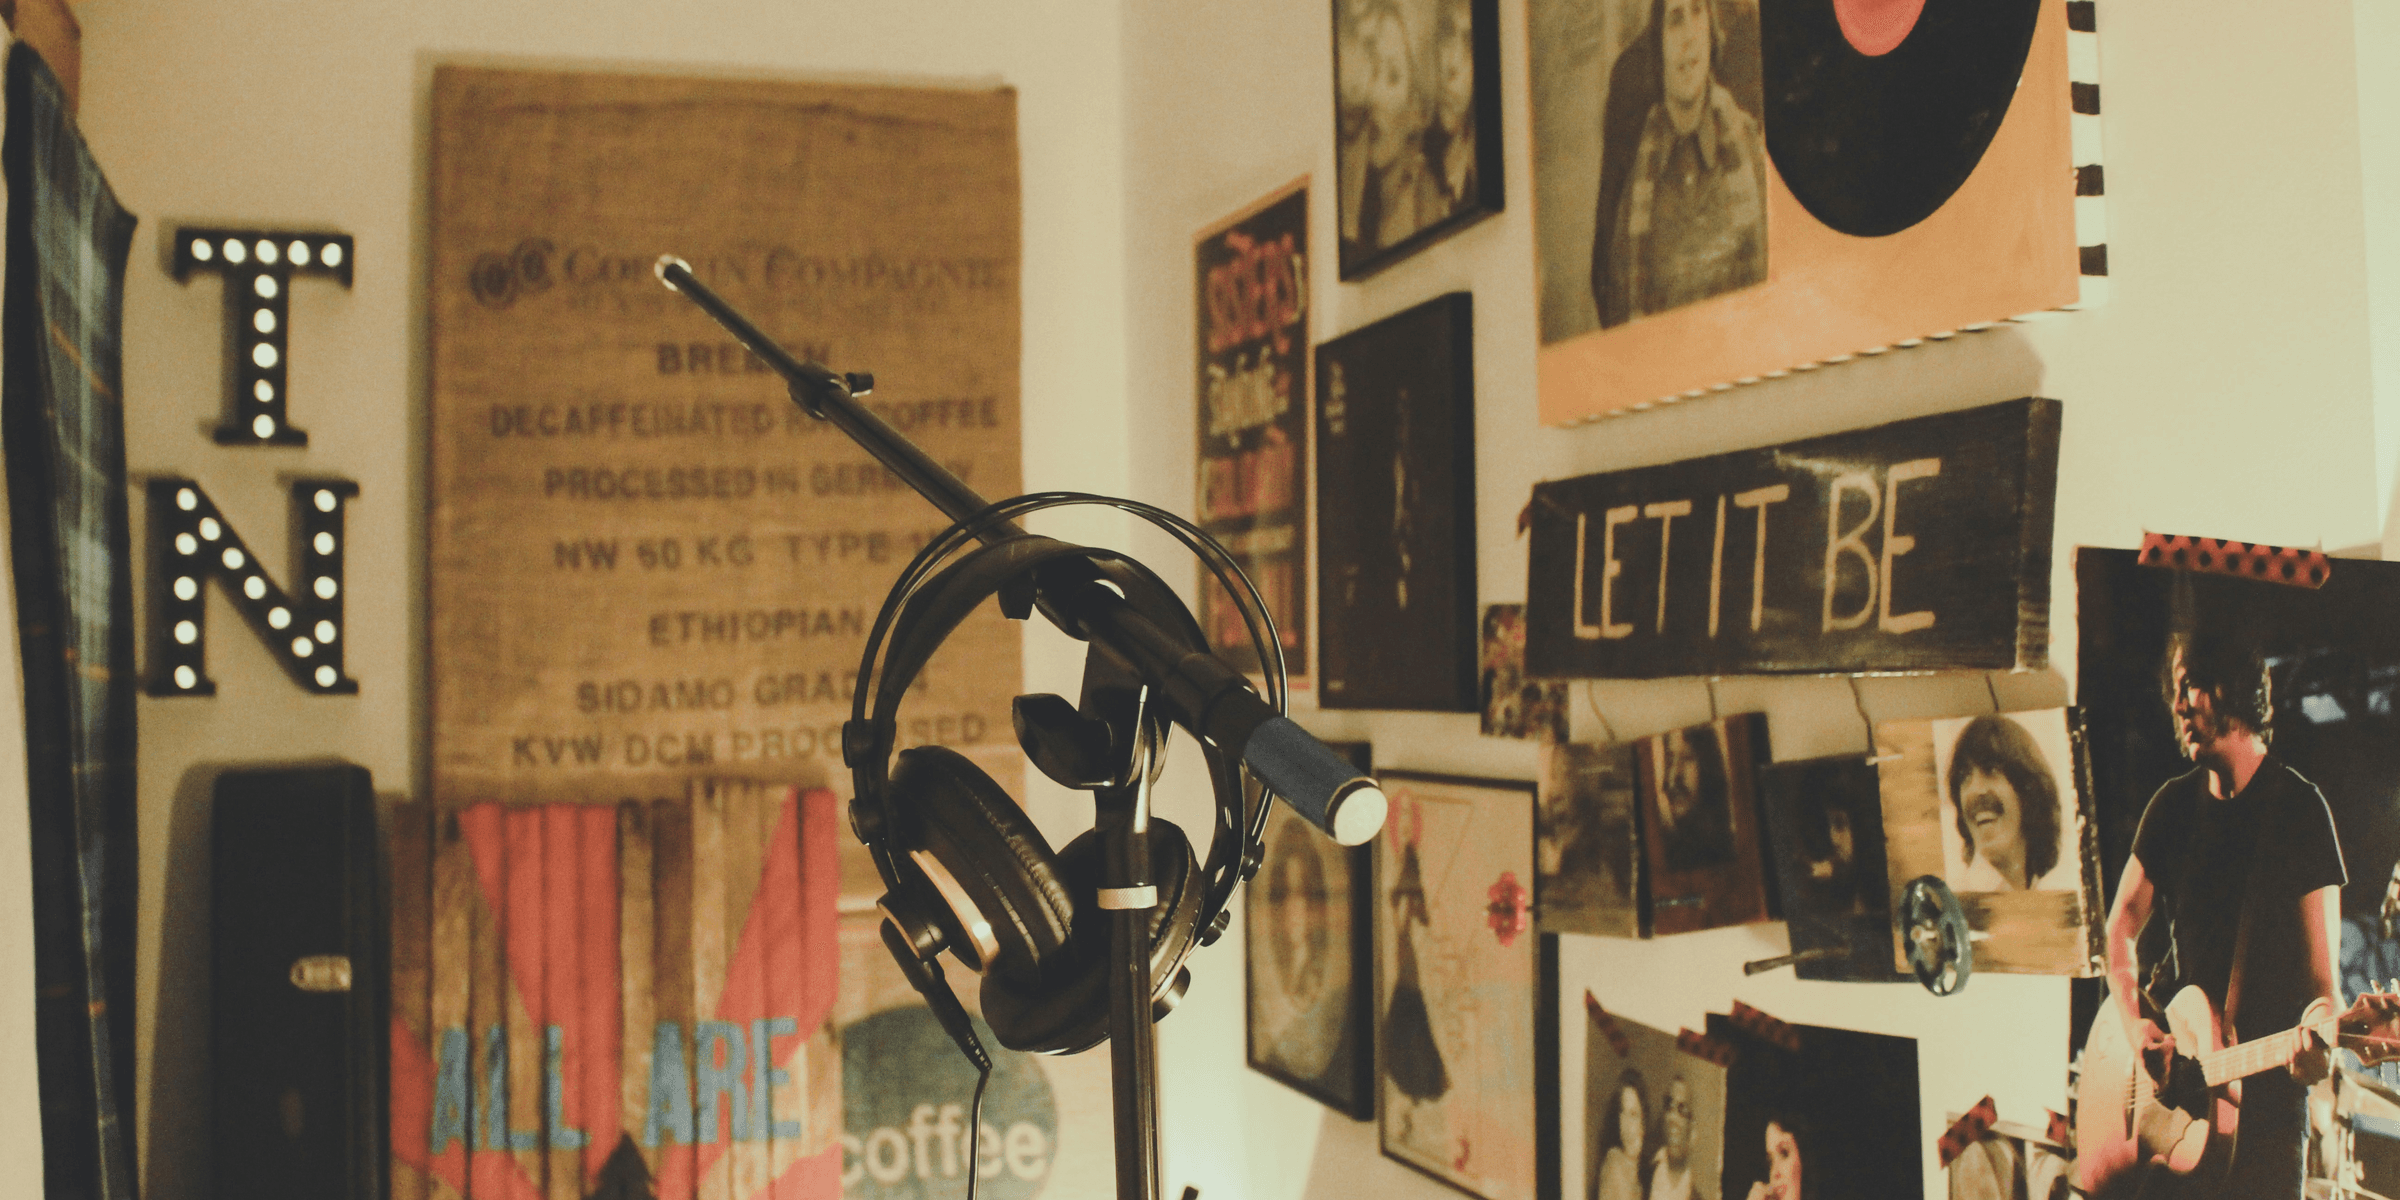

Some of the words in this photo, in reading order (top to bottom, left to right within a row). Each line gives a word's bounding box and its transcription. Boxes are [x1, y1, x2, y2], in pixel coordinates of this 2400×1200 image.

[174, 226, 353, 446] T
[489, 401, 774, 437] DECAFFEINATED
[544, 465, 756, 499] PROCESSED
[555, 539, 618, 571] NW
[696, 534, 755, 568] KG
[784, 529, 890, 565] TYPE
[1574, 500, 1692, 638] LET
[1708, 484, 1789, 638] IT
[1822, 458, 1941, 634] BE
[146, 478, 359, 697] N
[648, 608, 864, 647] ETHIOPIAN
[576, 678, 735, 715] SIDAMO
[512, 733, 602, 767] KVW
[430, 1022, 592, 1154] ALL
[641, 1016, 801, 1149] ARE
[842, 1103, 1048, 1183] coffee
